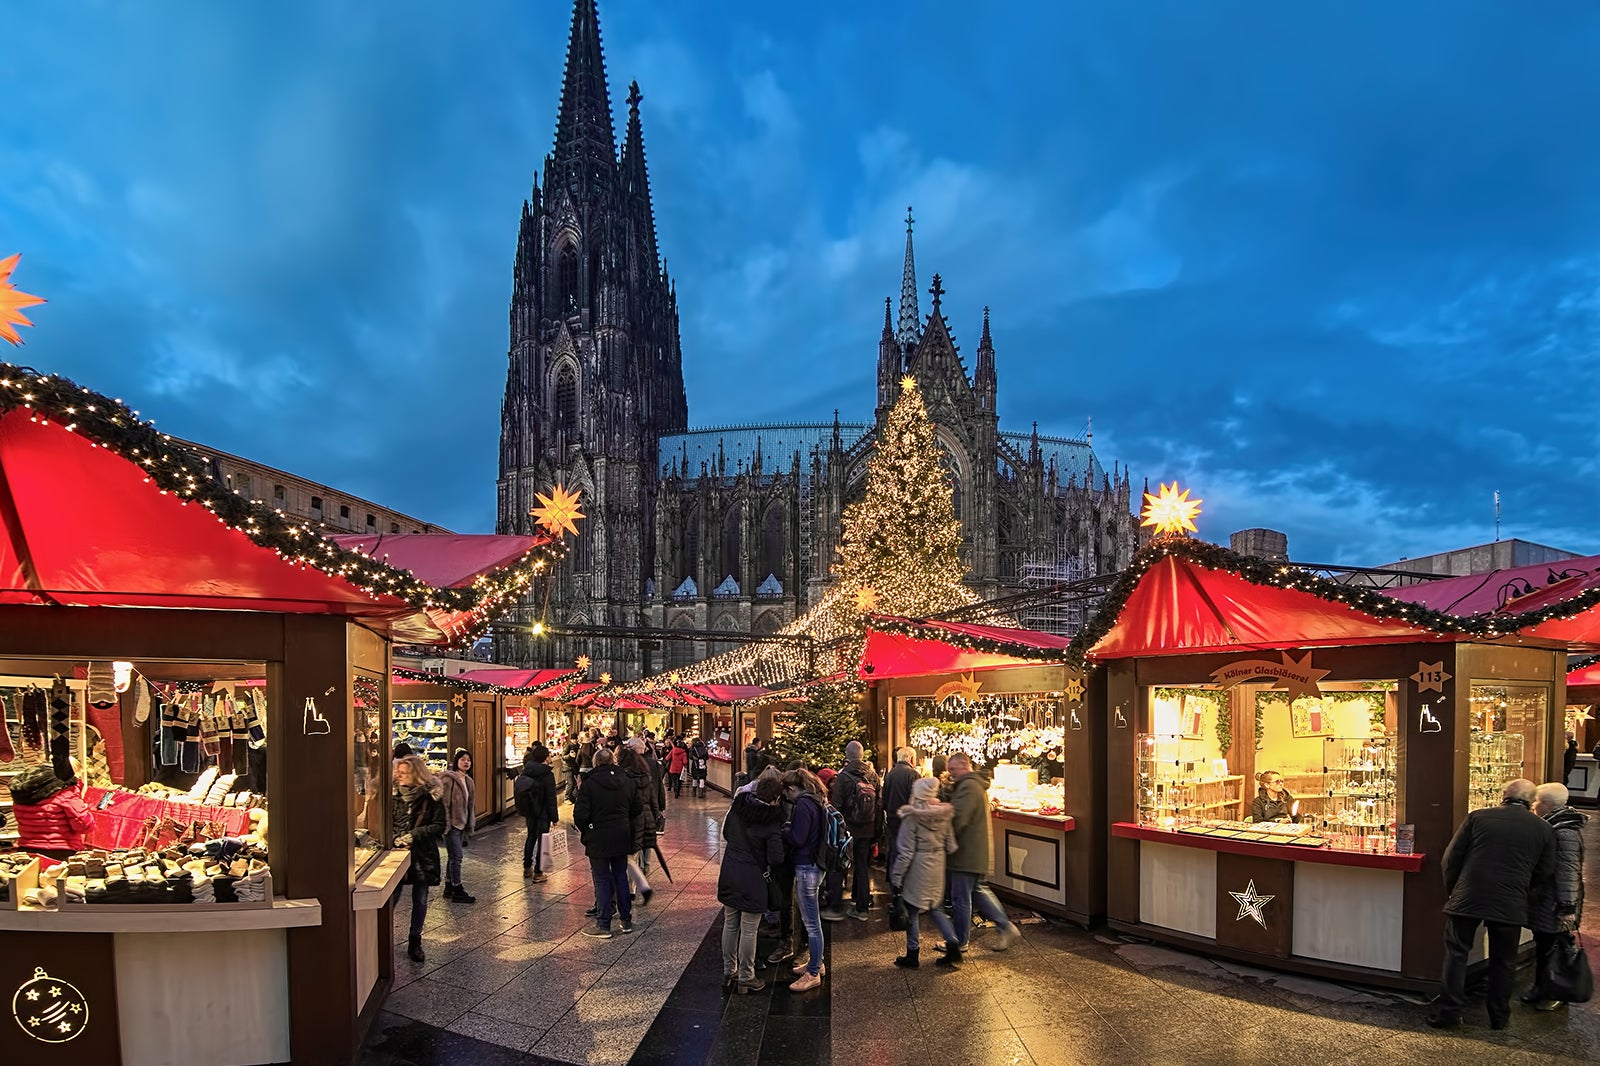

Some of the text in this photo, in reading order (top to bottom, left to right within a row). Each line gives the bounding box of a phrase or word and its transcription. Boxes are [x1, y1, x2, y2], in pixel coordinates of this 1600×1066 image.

[1224, 666, 1309, 684] Kölner Glasbläserei
[1419, 671, 1442, 683] 113
[1068, 685, 1080, 695] 112
